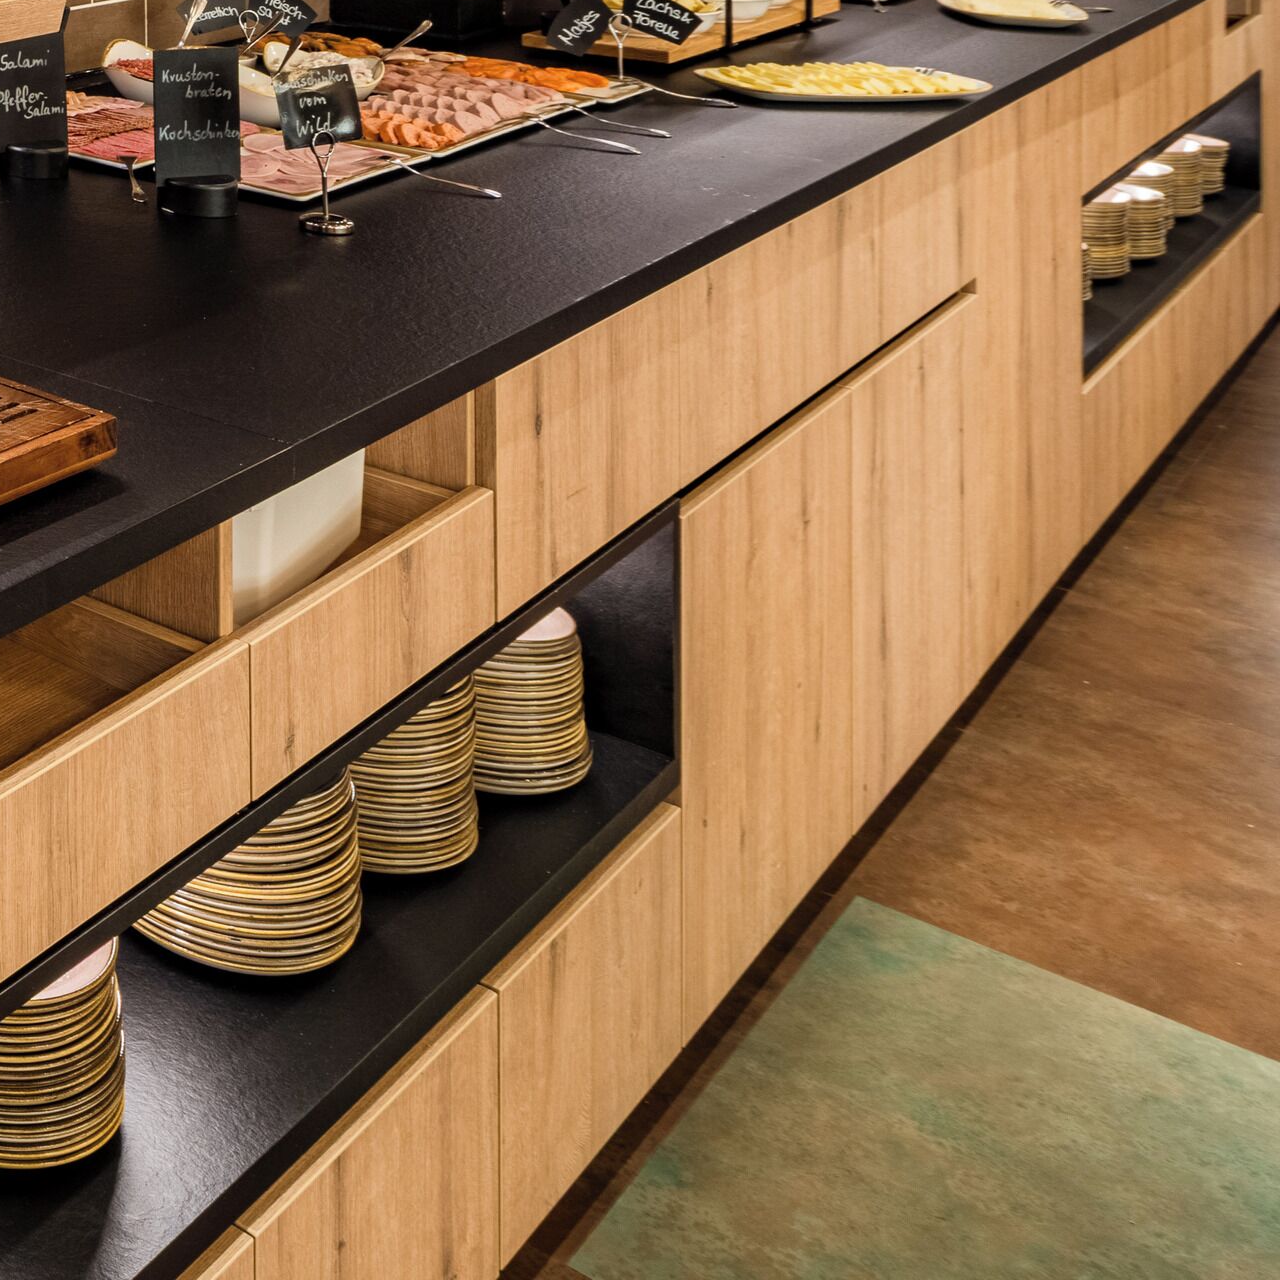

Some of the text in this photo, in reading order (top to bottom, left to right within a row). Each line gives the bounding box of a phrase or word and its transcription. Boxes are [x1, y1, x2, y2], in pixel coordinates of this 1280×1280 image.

[632, 10, 680, 40] Forelle
[0, 49, 51, 71] Salami
[185, 83, 232, 100] braten
[299, 96, 328, 109] vom
[296, 112, 336, 138] Wild
